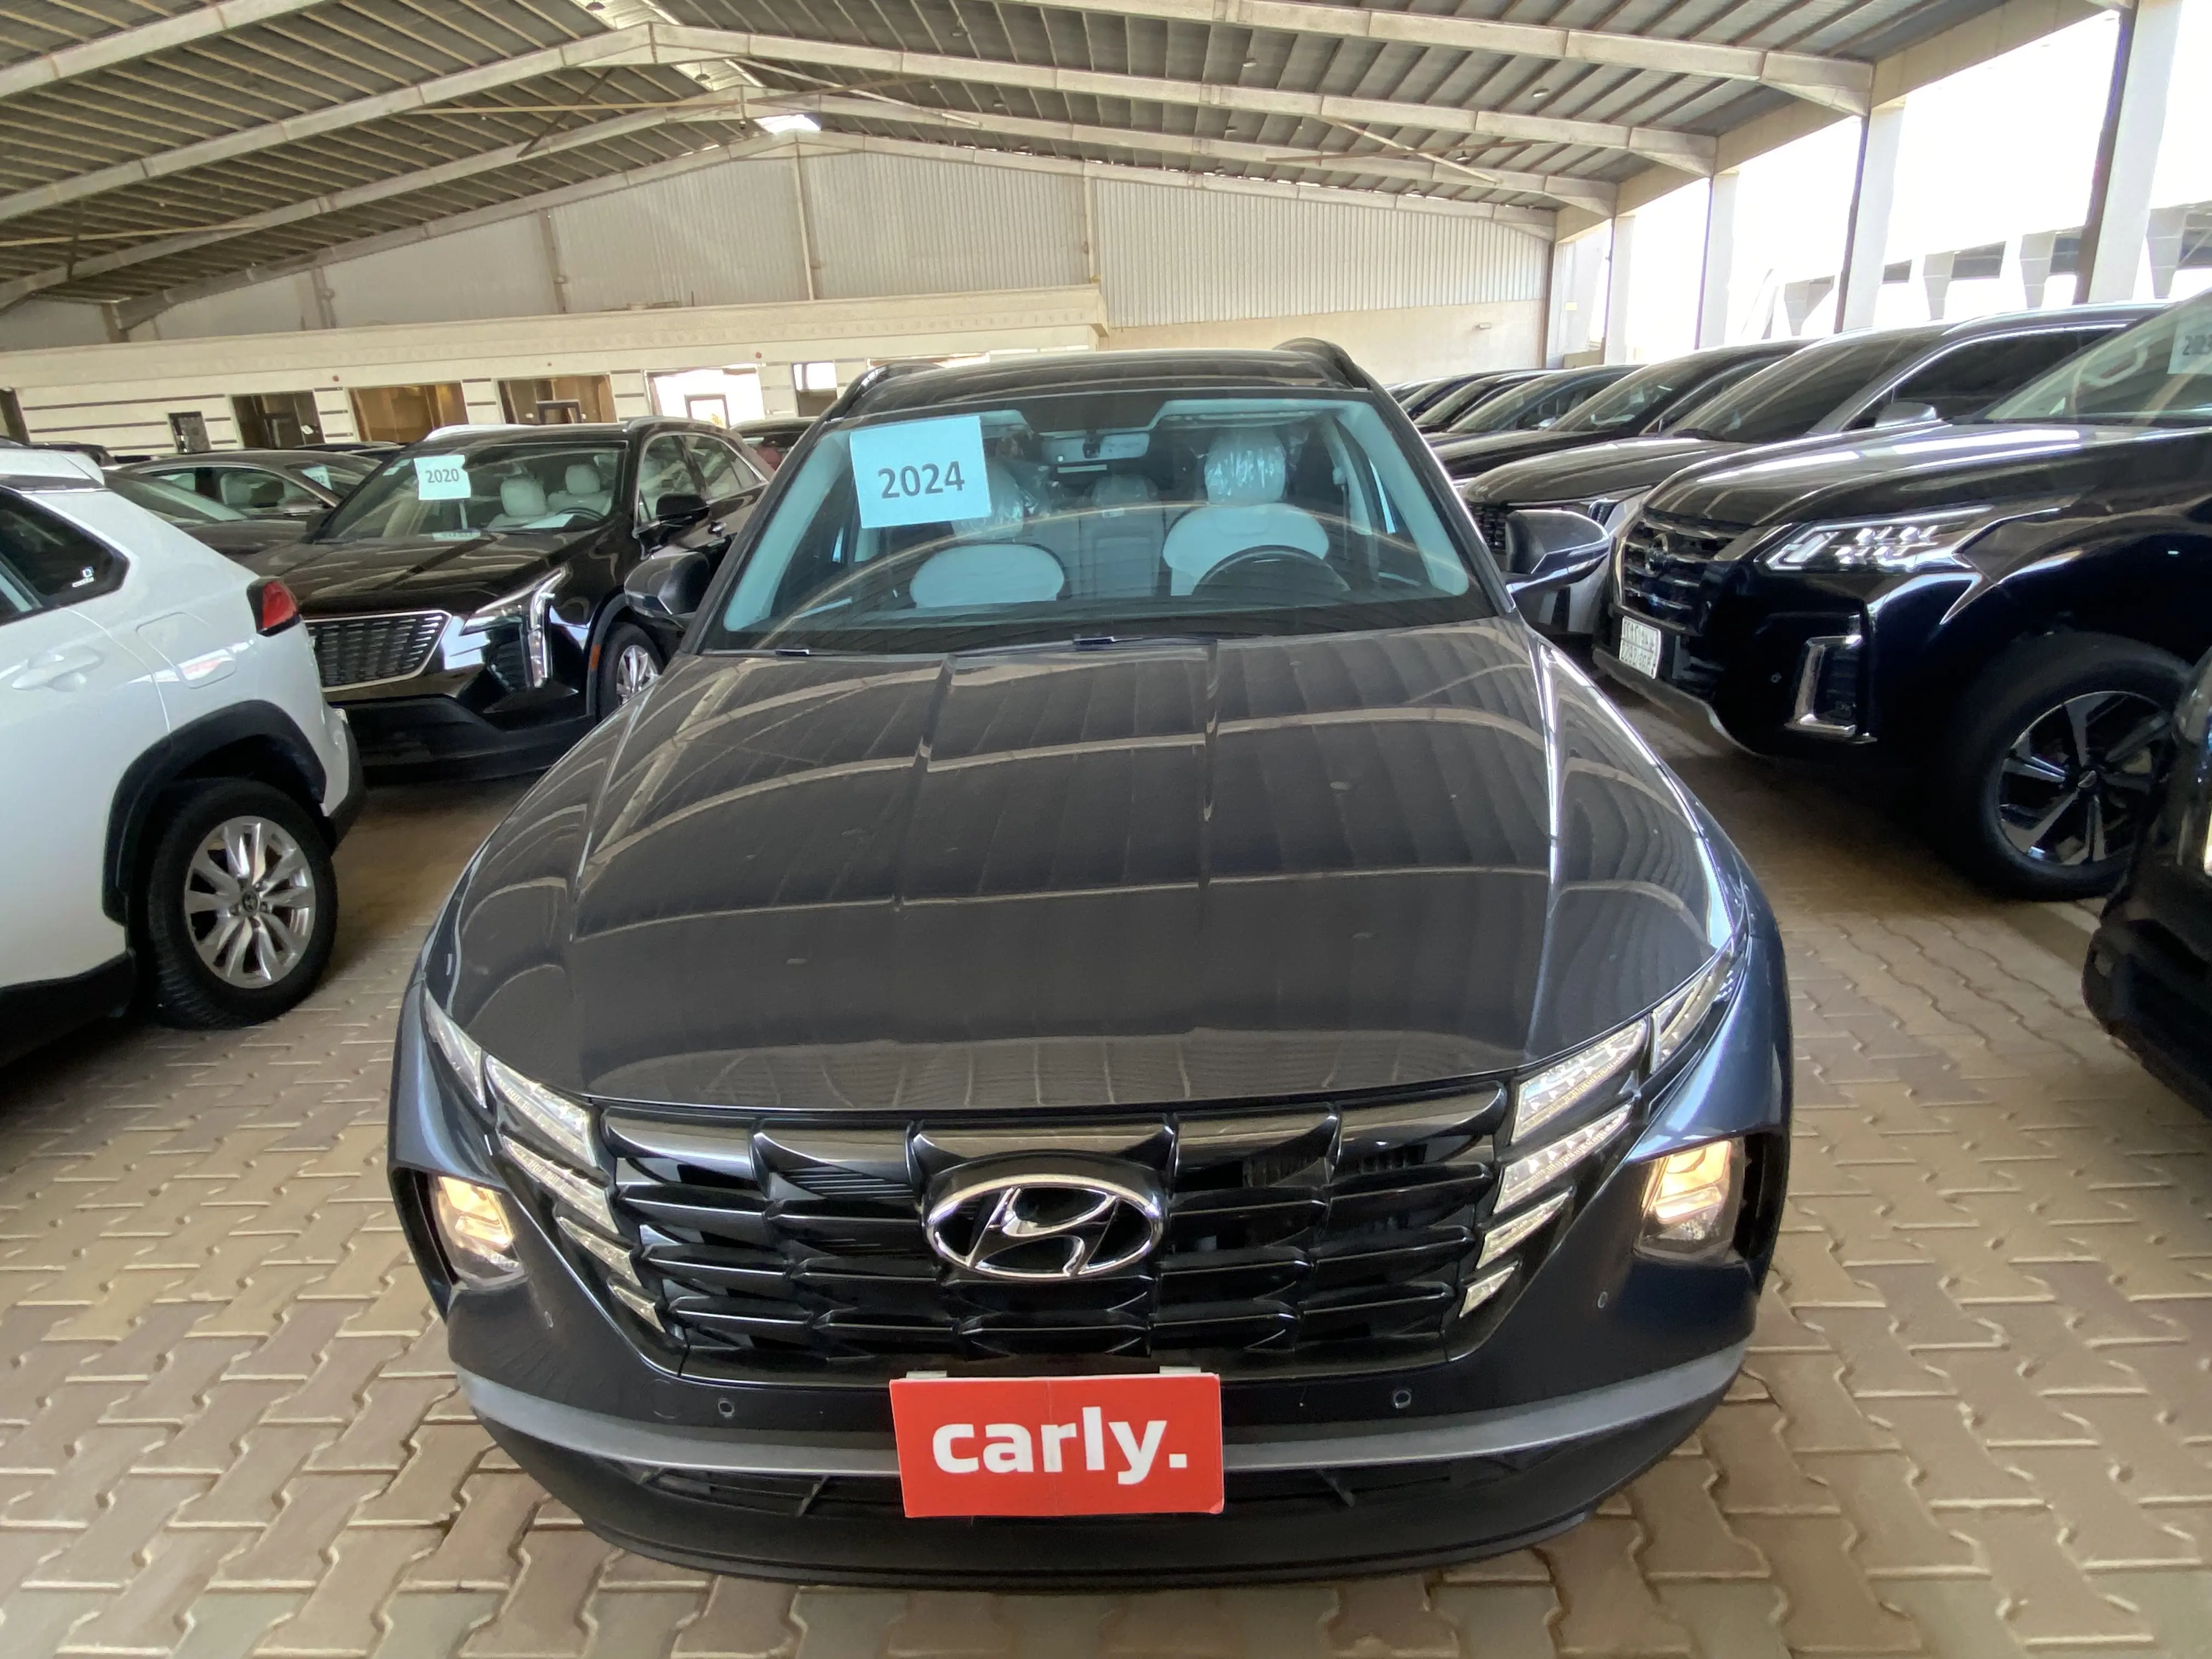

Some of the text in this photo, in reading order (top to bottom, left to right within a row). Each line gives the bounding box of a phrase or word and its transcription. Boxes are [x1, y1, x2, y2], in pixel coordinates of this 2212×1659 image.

[425, 469, 459, 483] 2020
[878, 461, 965, 499] 2024
[933, 1406, 1187, 1485] carly.
